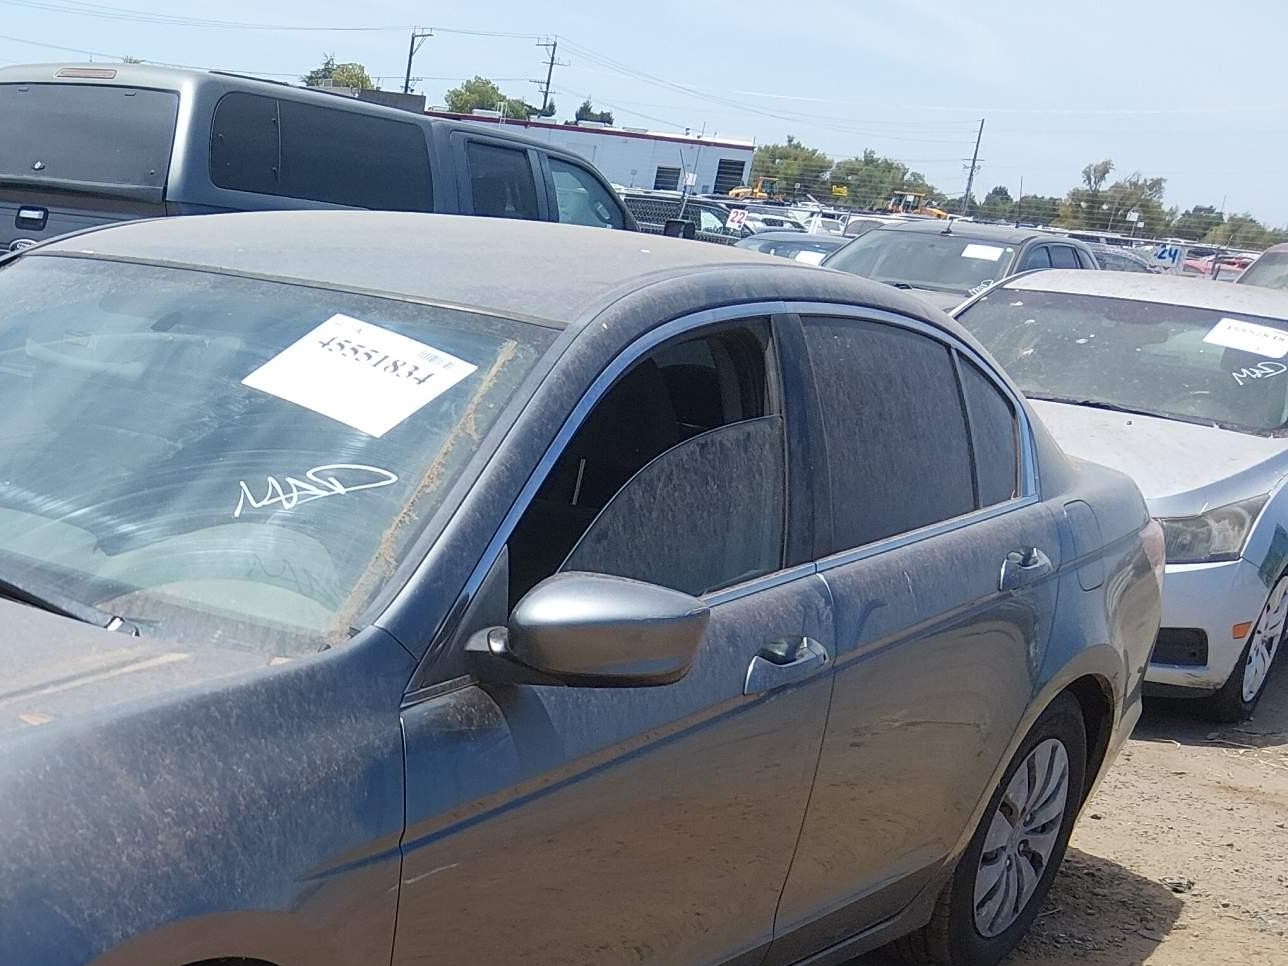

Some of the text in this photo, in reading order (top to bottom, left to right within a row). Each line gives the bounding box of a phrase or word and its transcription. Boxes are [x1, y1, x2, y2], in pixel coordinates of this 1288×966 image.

[730, 210, 746, 225] 22
[1157, 244, 1179, 264] 24
[317, 336, 435, 385] 45551834
